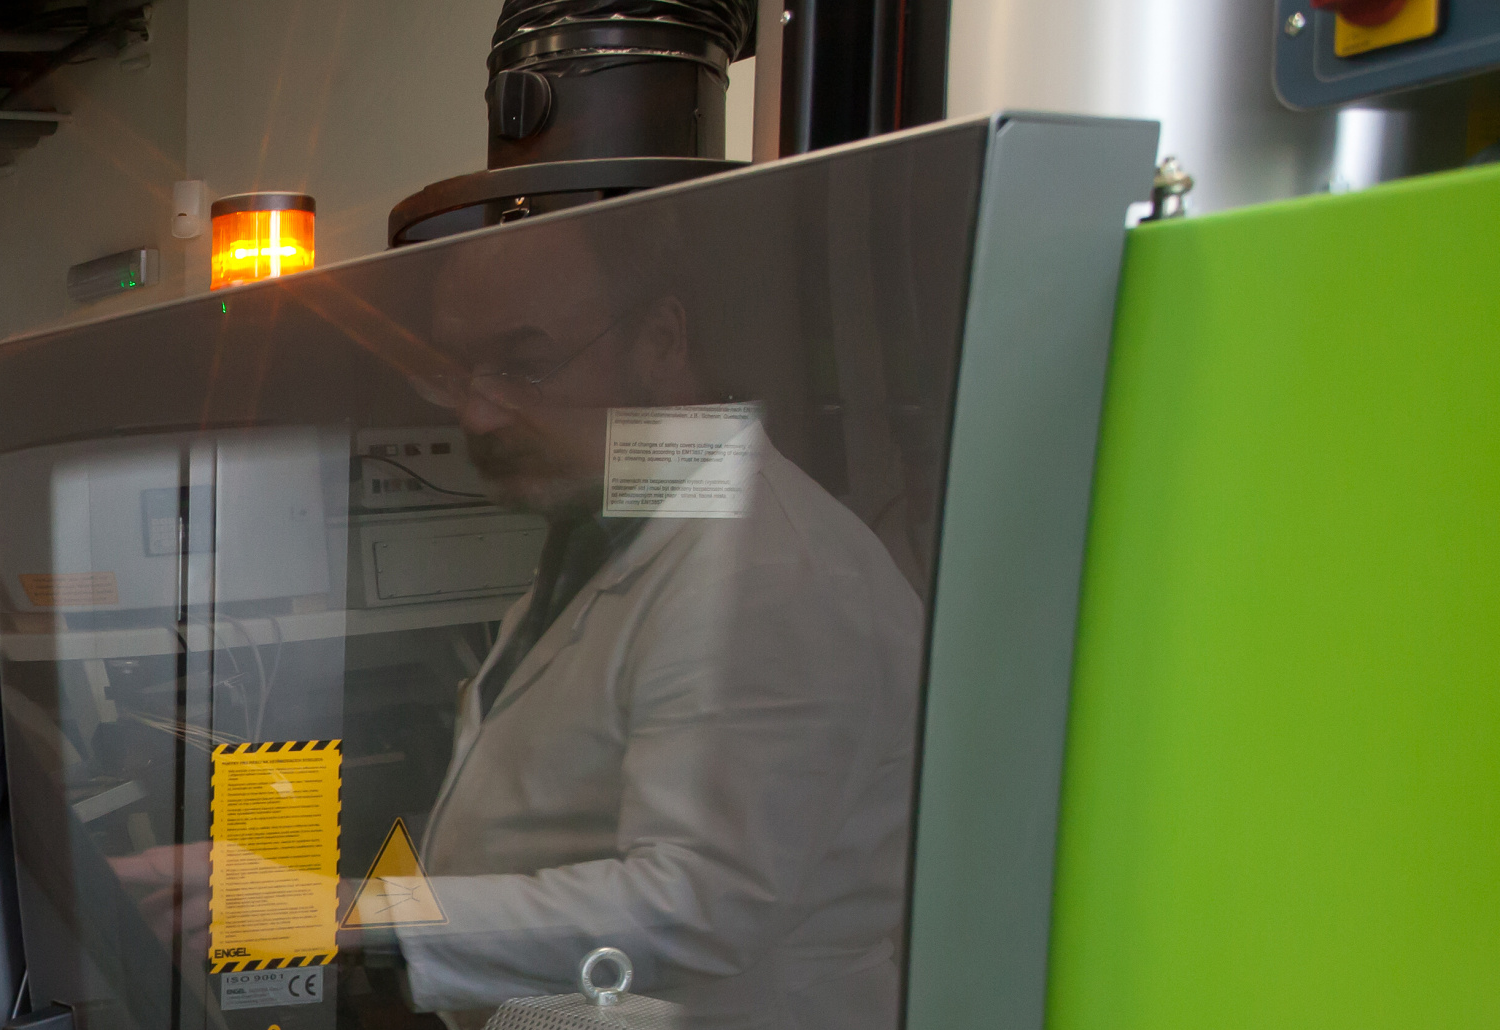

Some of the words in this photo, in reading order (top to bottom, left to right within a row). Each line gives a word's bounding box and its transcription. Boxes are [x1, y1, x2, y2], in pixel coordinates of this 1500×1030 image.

[214, 947, 252, 959] ENGEL
[226, 975, 250, 984] ISO
[254, 973, 284, 981] 9001
